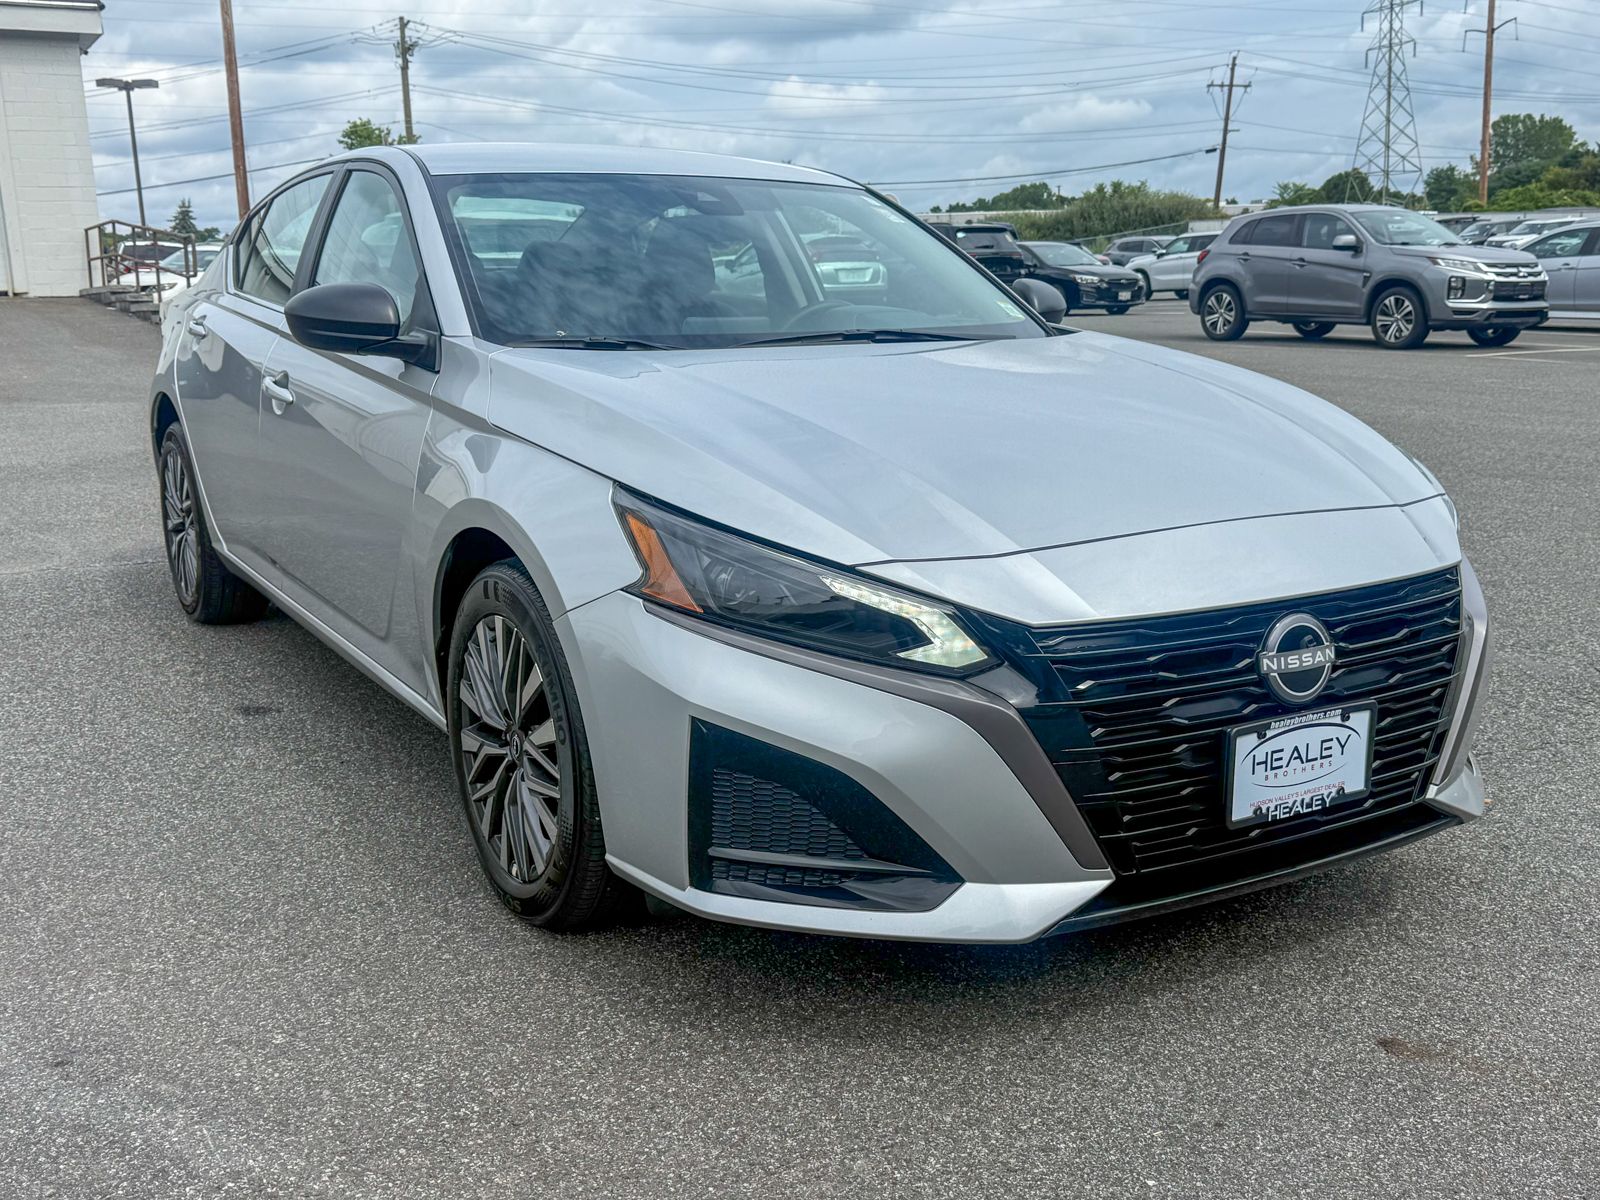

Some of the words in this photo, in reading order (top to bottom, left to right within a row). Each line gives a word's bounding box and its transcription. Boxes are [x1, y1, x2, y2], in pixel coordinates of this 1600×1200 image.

[1263, 646, 1335, 671] NISSAN
[1270, 709, 1342, 729] healeybrothers.com
[1251, 734, 1352, 776] HEALEY
[1264, 761, 1333, 781] BROTHERS
[1249, 798, 1274, 808] HUDSON
[1273, 792, 1300, 803] VALLEY'S
[1300, 786, 1324, 797] LARGEST
[1324, 781, 1346, 791] DEALER
[1268, 791, 1332, 821] HEALEY
